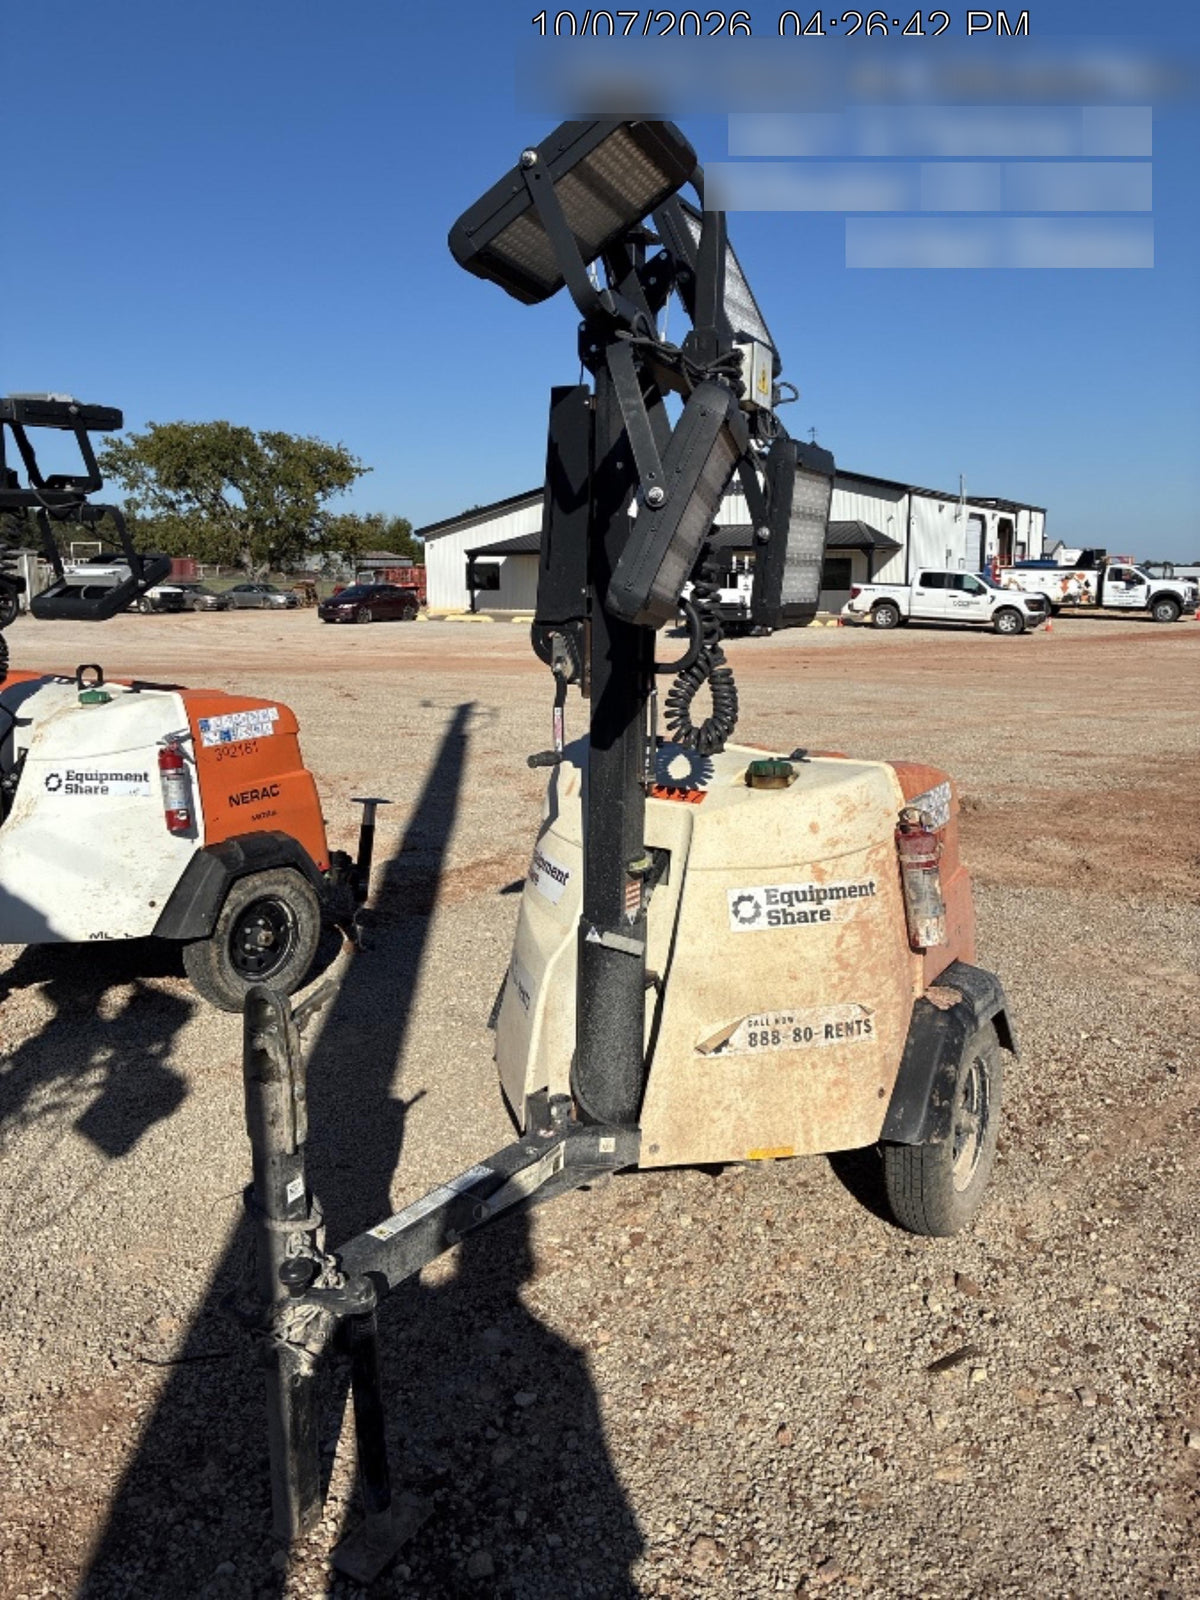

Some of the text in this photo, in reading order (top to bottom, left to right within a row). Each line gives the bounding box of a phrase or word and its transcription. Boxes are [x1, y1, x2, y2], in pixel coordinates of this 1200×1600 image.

[64, 769, 150, 784] Equipment
[64, 783, 109, 795] Share
[228, 783, 281, 808] NERAC
[764, 880, 876, 907] Equipment
[765, 907, 832, 926] Share
[747, 1017, 770, 1027] CALL
